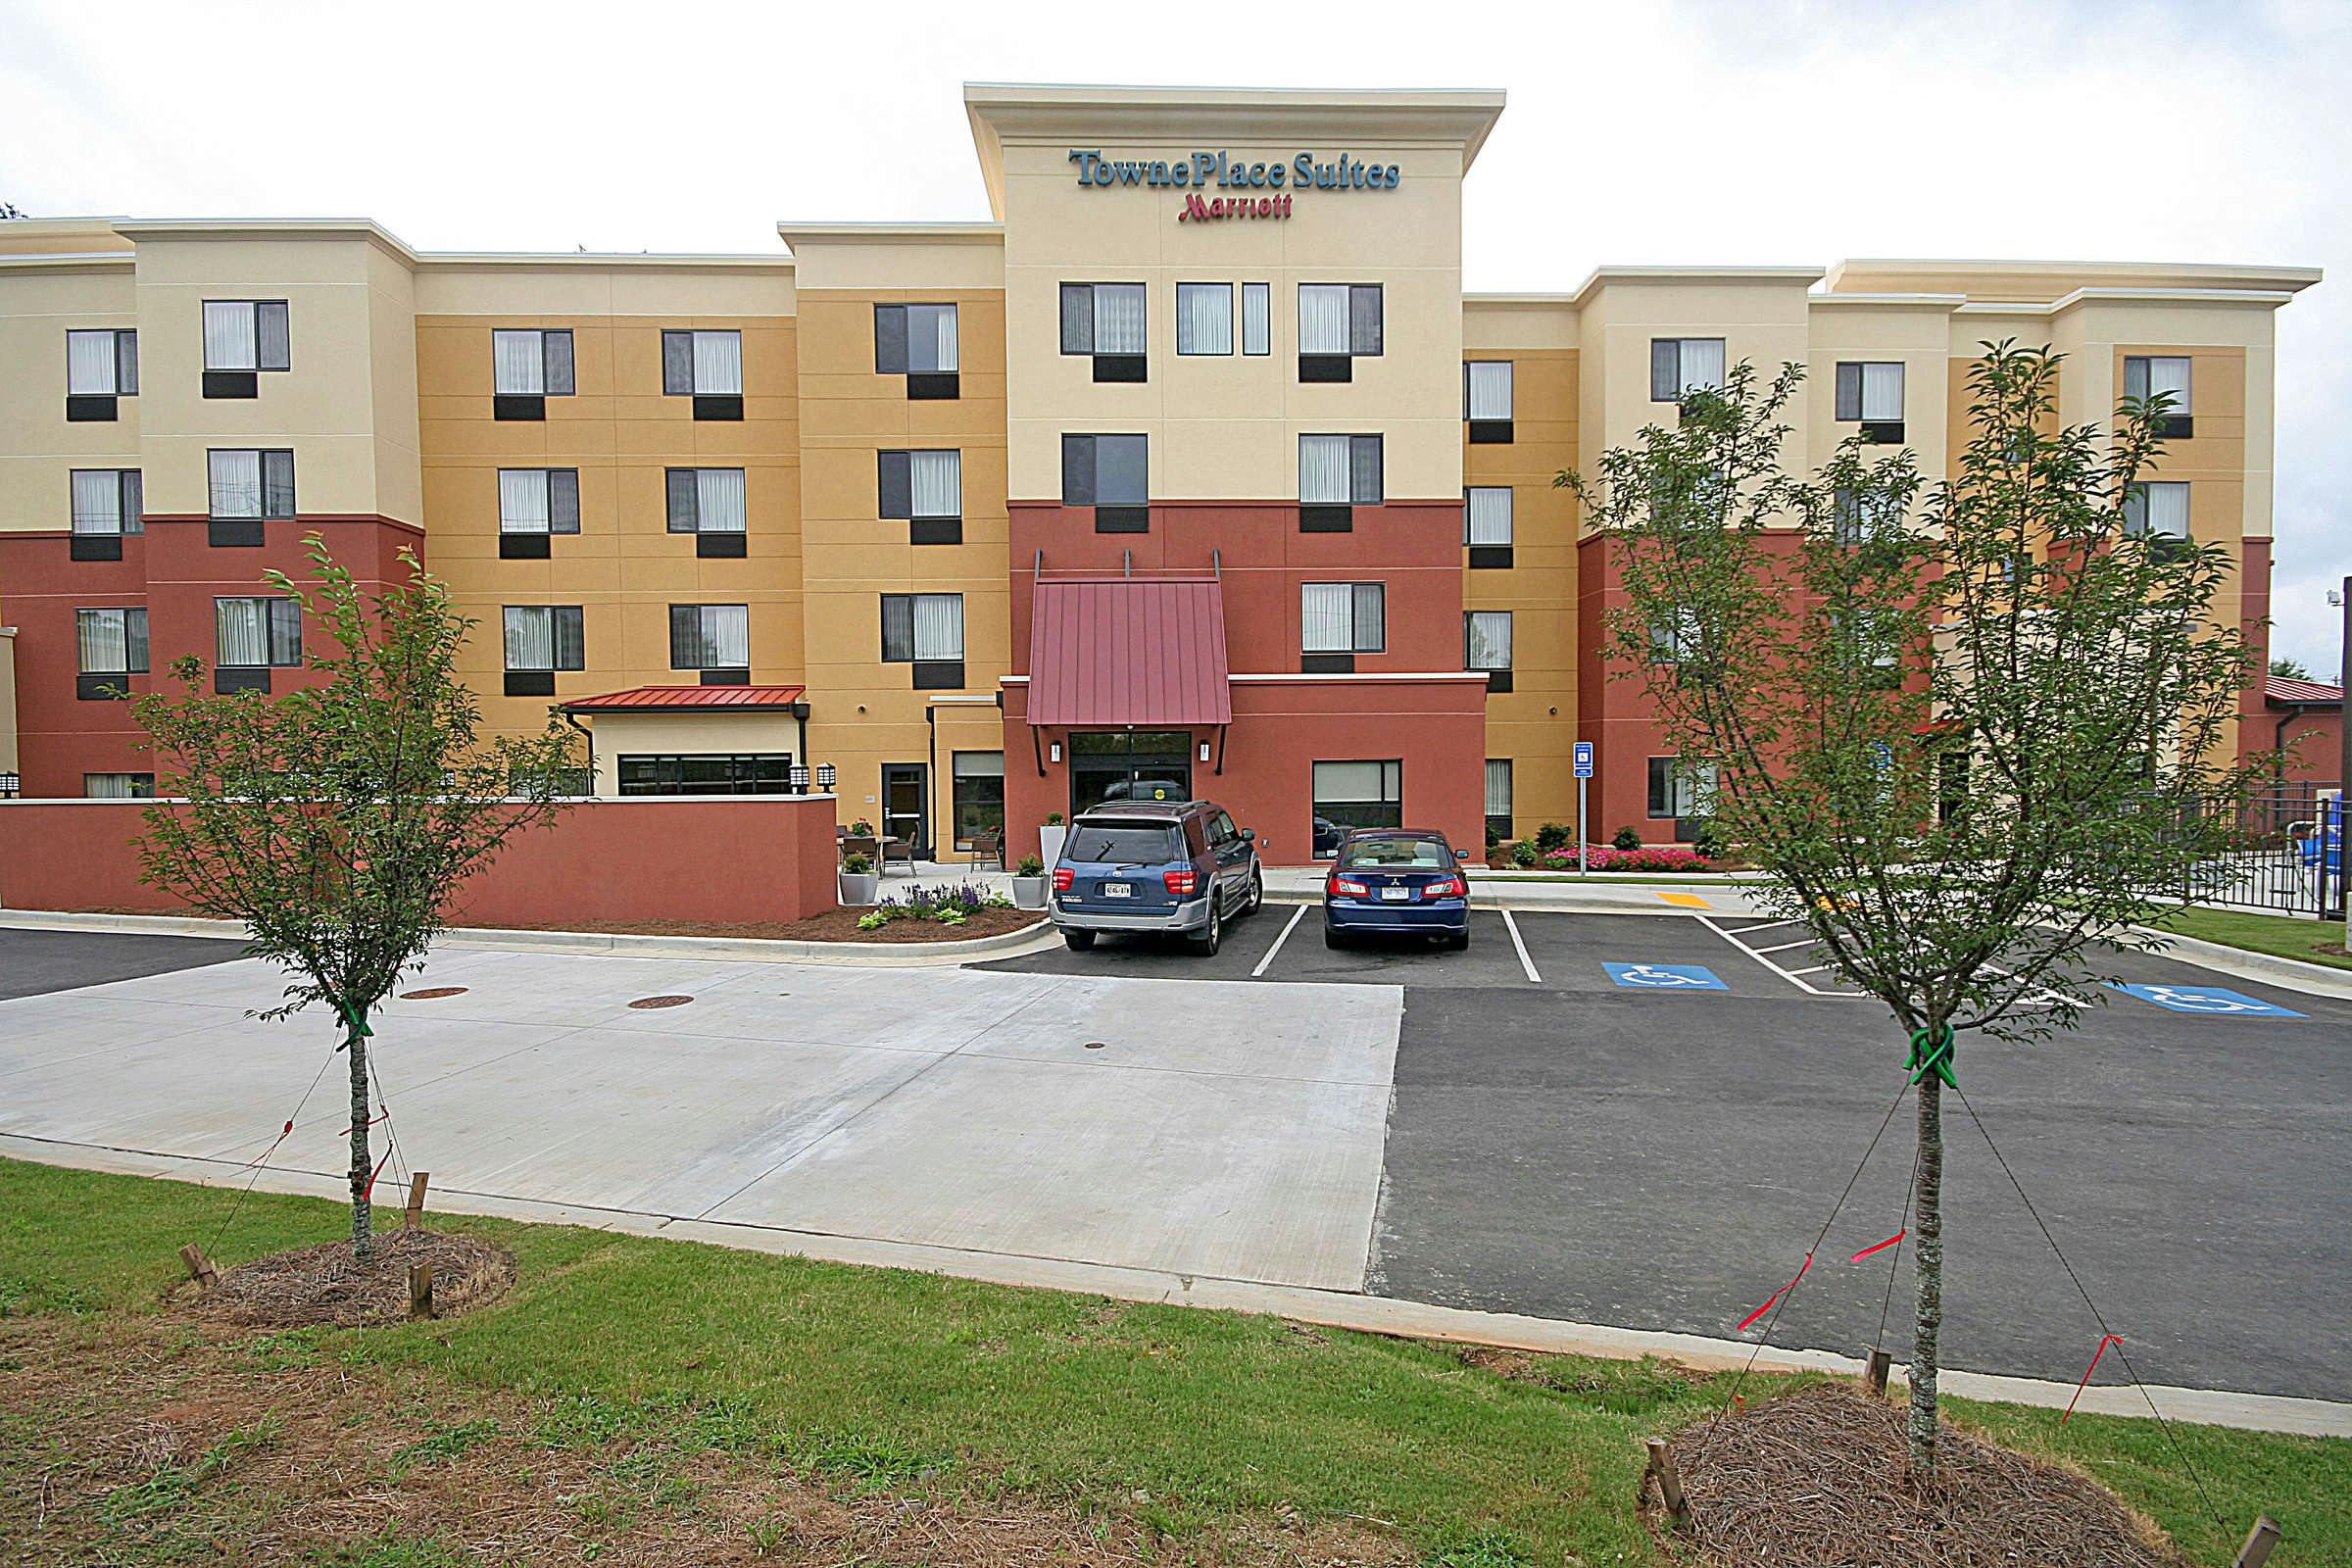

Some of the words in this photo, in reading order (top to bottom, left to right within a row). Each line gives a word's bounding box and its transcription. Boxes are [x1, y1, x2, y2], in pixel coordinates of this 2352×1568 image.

[1068, 148, 1287, 187] TownePlace
[1292, 151, 1401, 189] Suites
[1177, 193, 1294, 222] Marriott
